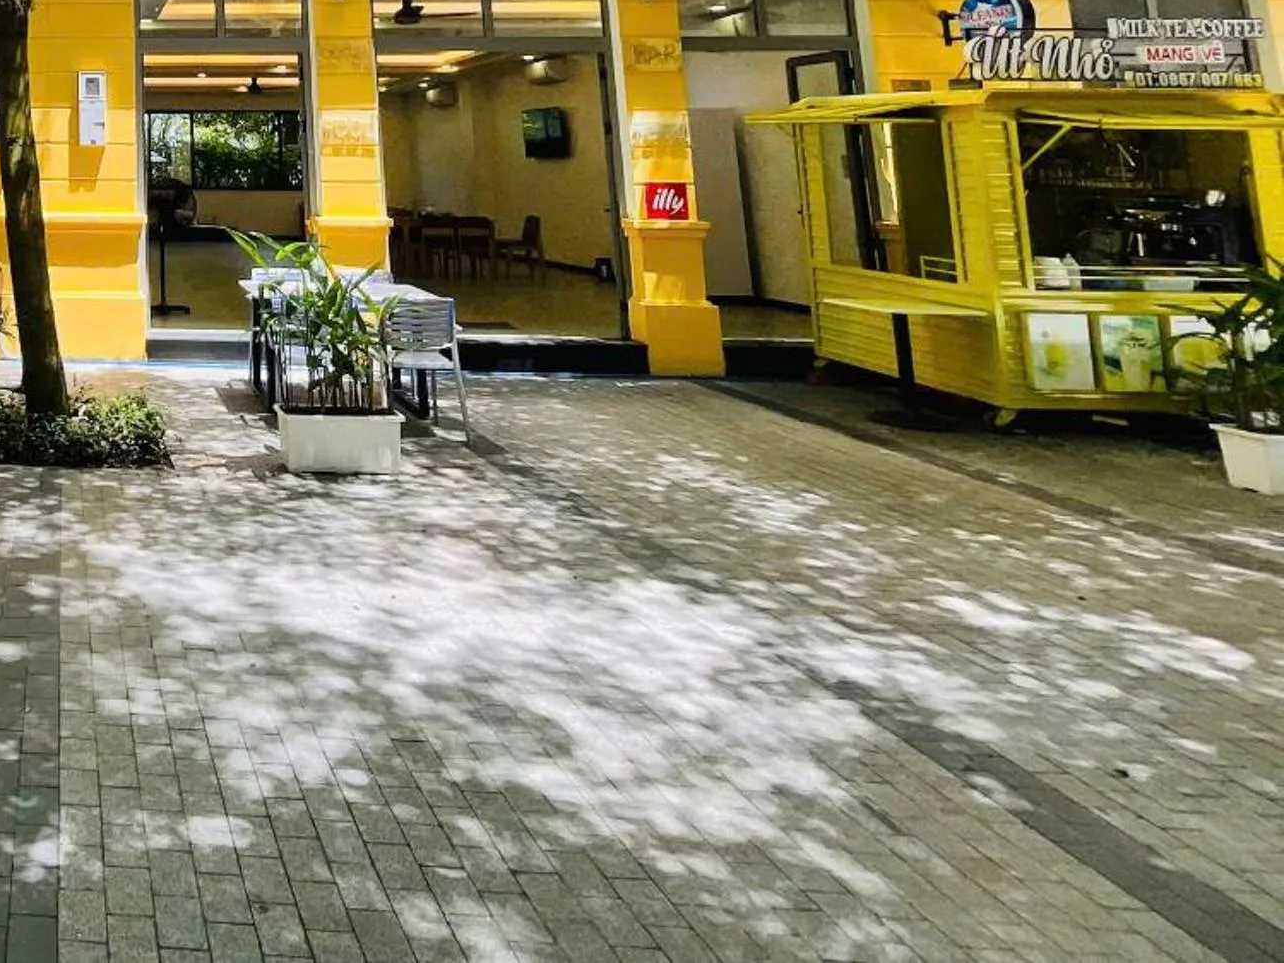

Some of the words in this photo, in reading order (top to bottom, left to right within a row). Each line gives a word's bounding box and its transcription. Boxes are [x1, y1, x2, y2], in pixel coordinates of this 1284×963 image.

[1117, 18, 1159, 38] MILK
[1028, 37, 1115, 80] Nhỏ
[1146, 47, 1194, 62] MANG
[651, 187, 685, 215] illy
